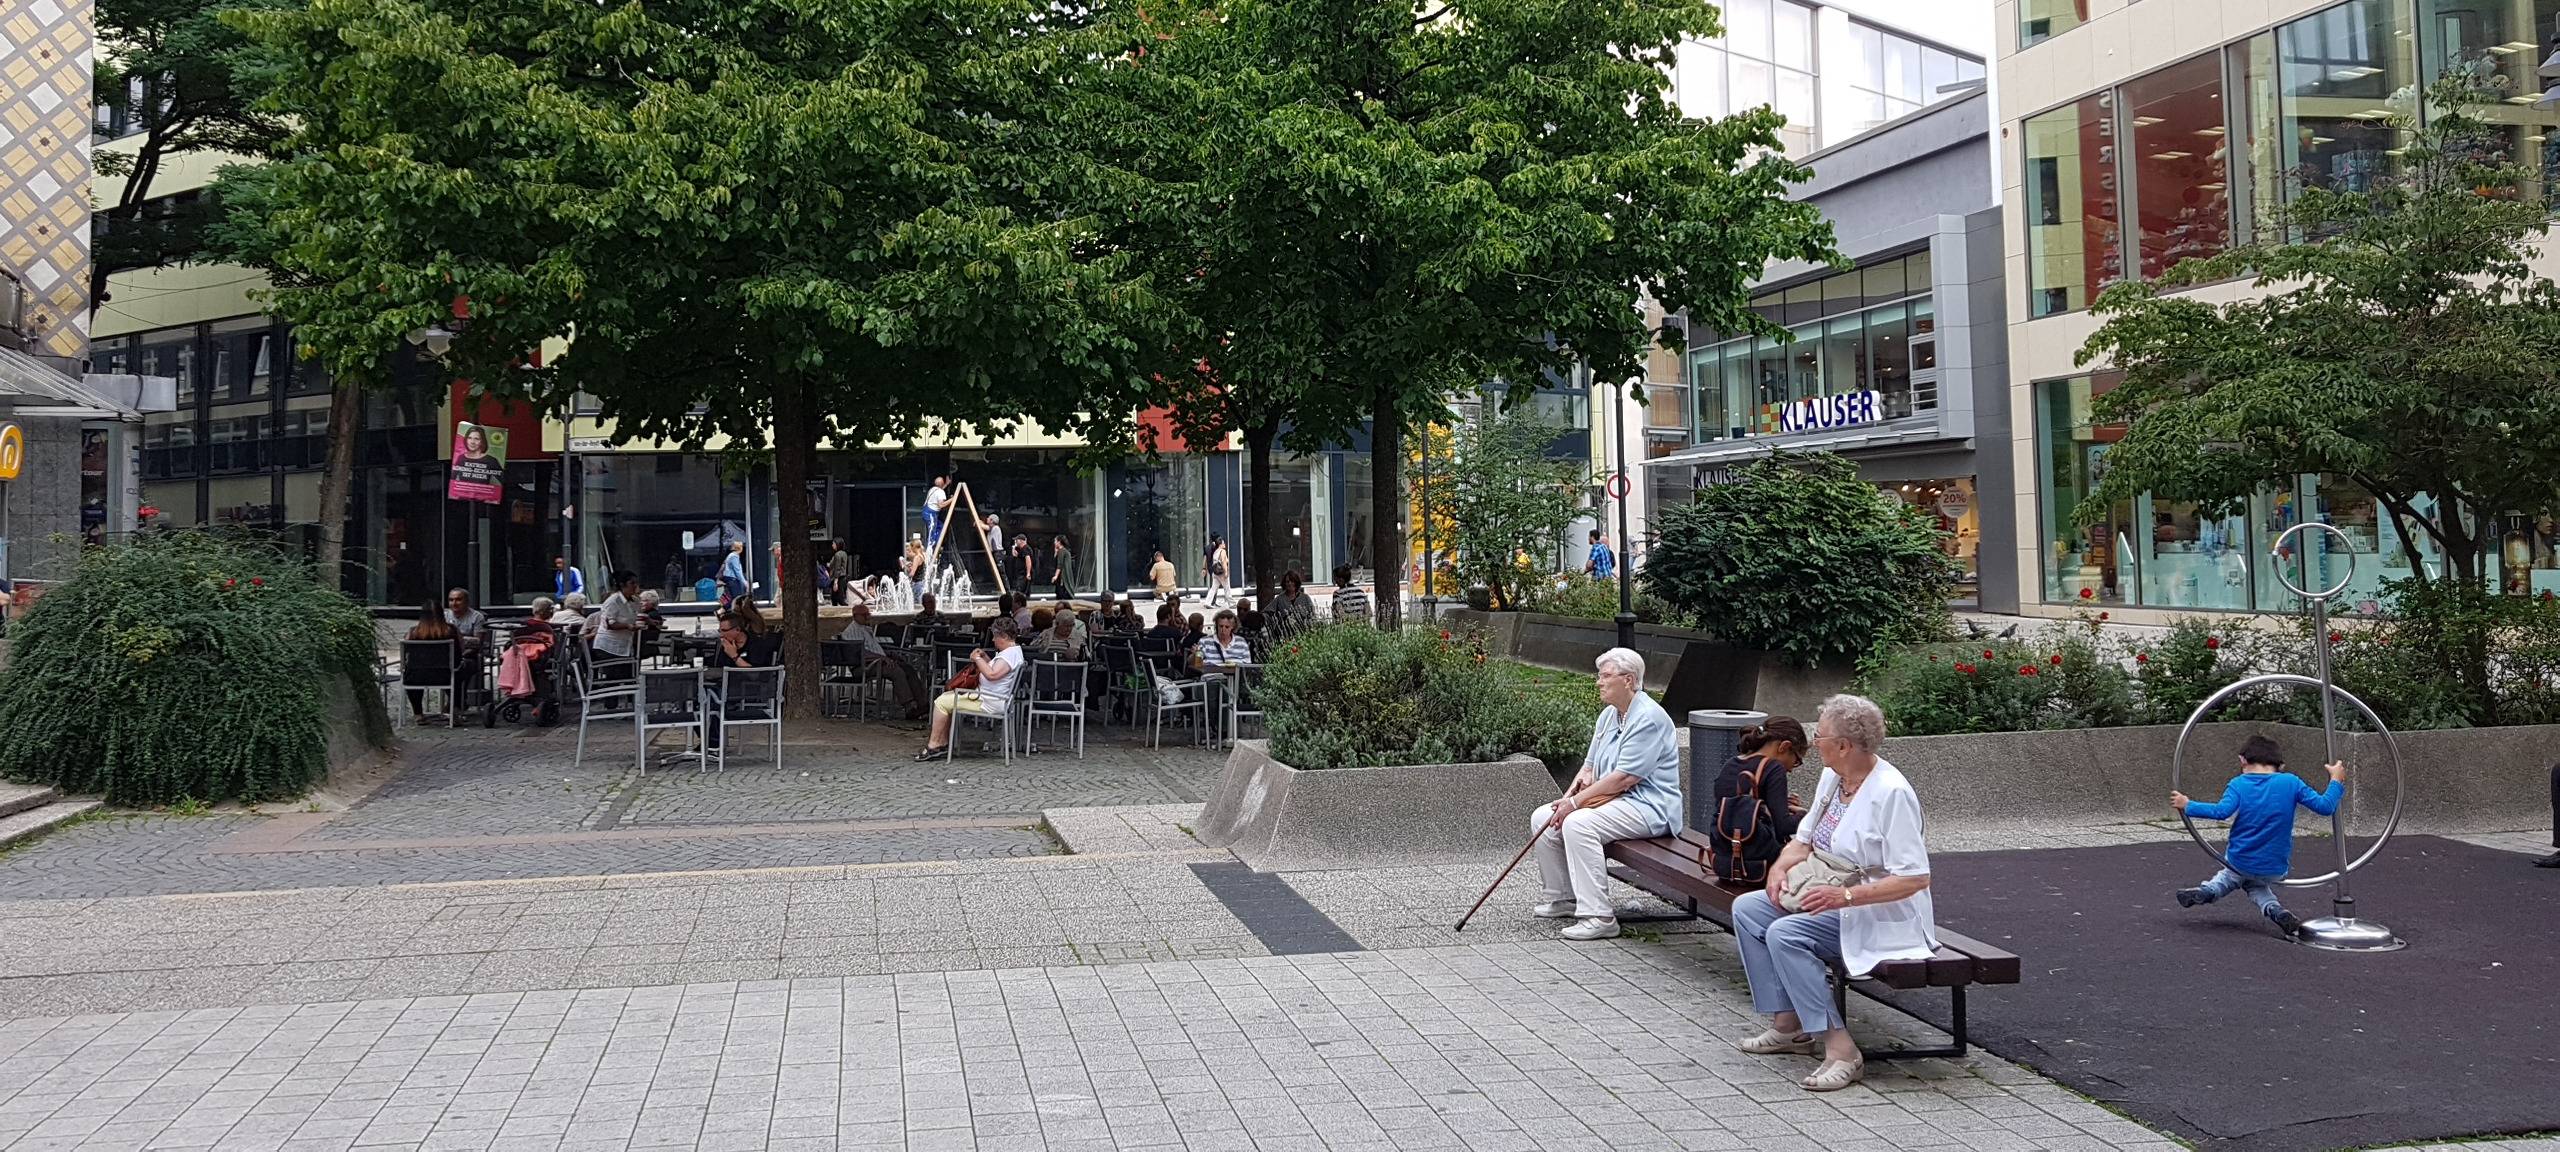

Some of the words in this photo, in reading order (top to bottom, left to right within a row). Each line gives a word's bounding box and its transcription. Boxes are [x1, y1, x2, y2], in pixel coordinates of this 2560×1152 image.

[1779, 389, 1875, 432] KLAUSER
[1695, 468, 1748, 489] KLAUS
[1943, 493, 1967, 504] 20%
